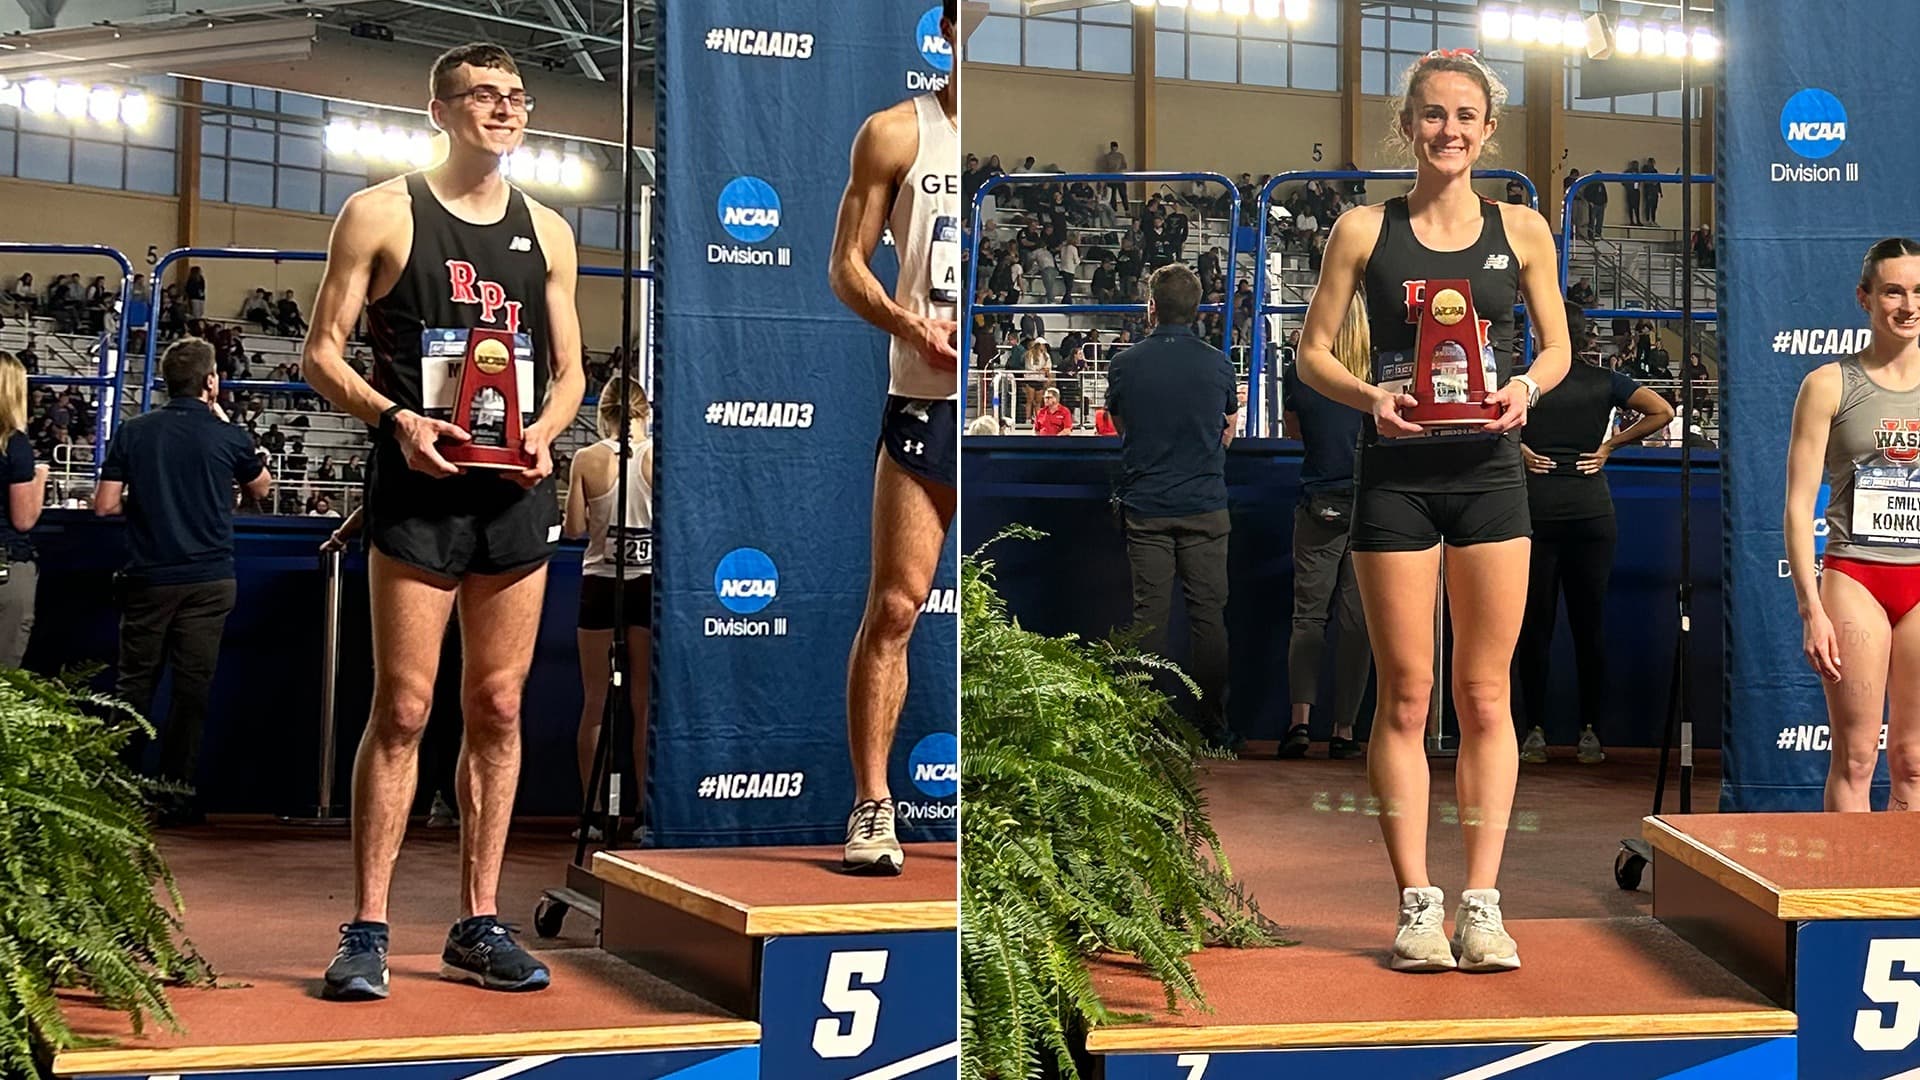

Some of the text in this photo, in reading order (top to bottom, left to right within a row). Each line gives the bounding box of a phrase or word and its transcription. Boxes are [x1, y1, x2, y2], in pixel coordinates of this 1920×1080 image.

[704, 27, 815, 59] #NCAAD3
[921, 34, 953, 55] NC
[906, 70, 949, 91] Divis
[1787, 121, 1846, 141] NCAA
[1312, 143, 1323, 162] 5
[1771, 163, 1840, 182] Division
[724, 206, 780, 228] NCAA
[146, 245, 158, 265] 5
[707, 244, 774, 264] Division
[445, 259, 523, 333] RPI
[1772, 328, 1872, 356] #NCAAD
[704, 401, 815, 428] #NCAAD3
[1874, 431, 1920, 449] WAS
[613, 540, 650, 560] 29
[720, 579, 777, 597] NCAA
[704, 617, 770, 636] Division
[697, 772, 804, 799] #NCAAD3
[812, 949, 889, 1059] 5
[1853, 938, 1920, 1052] 5
